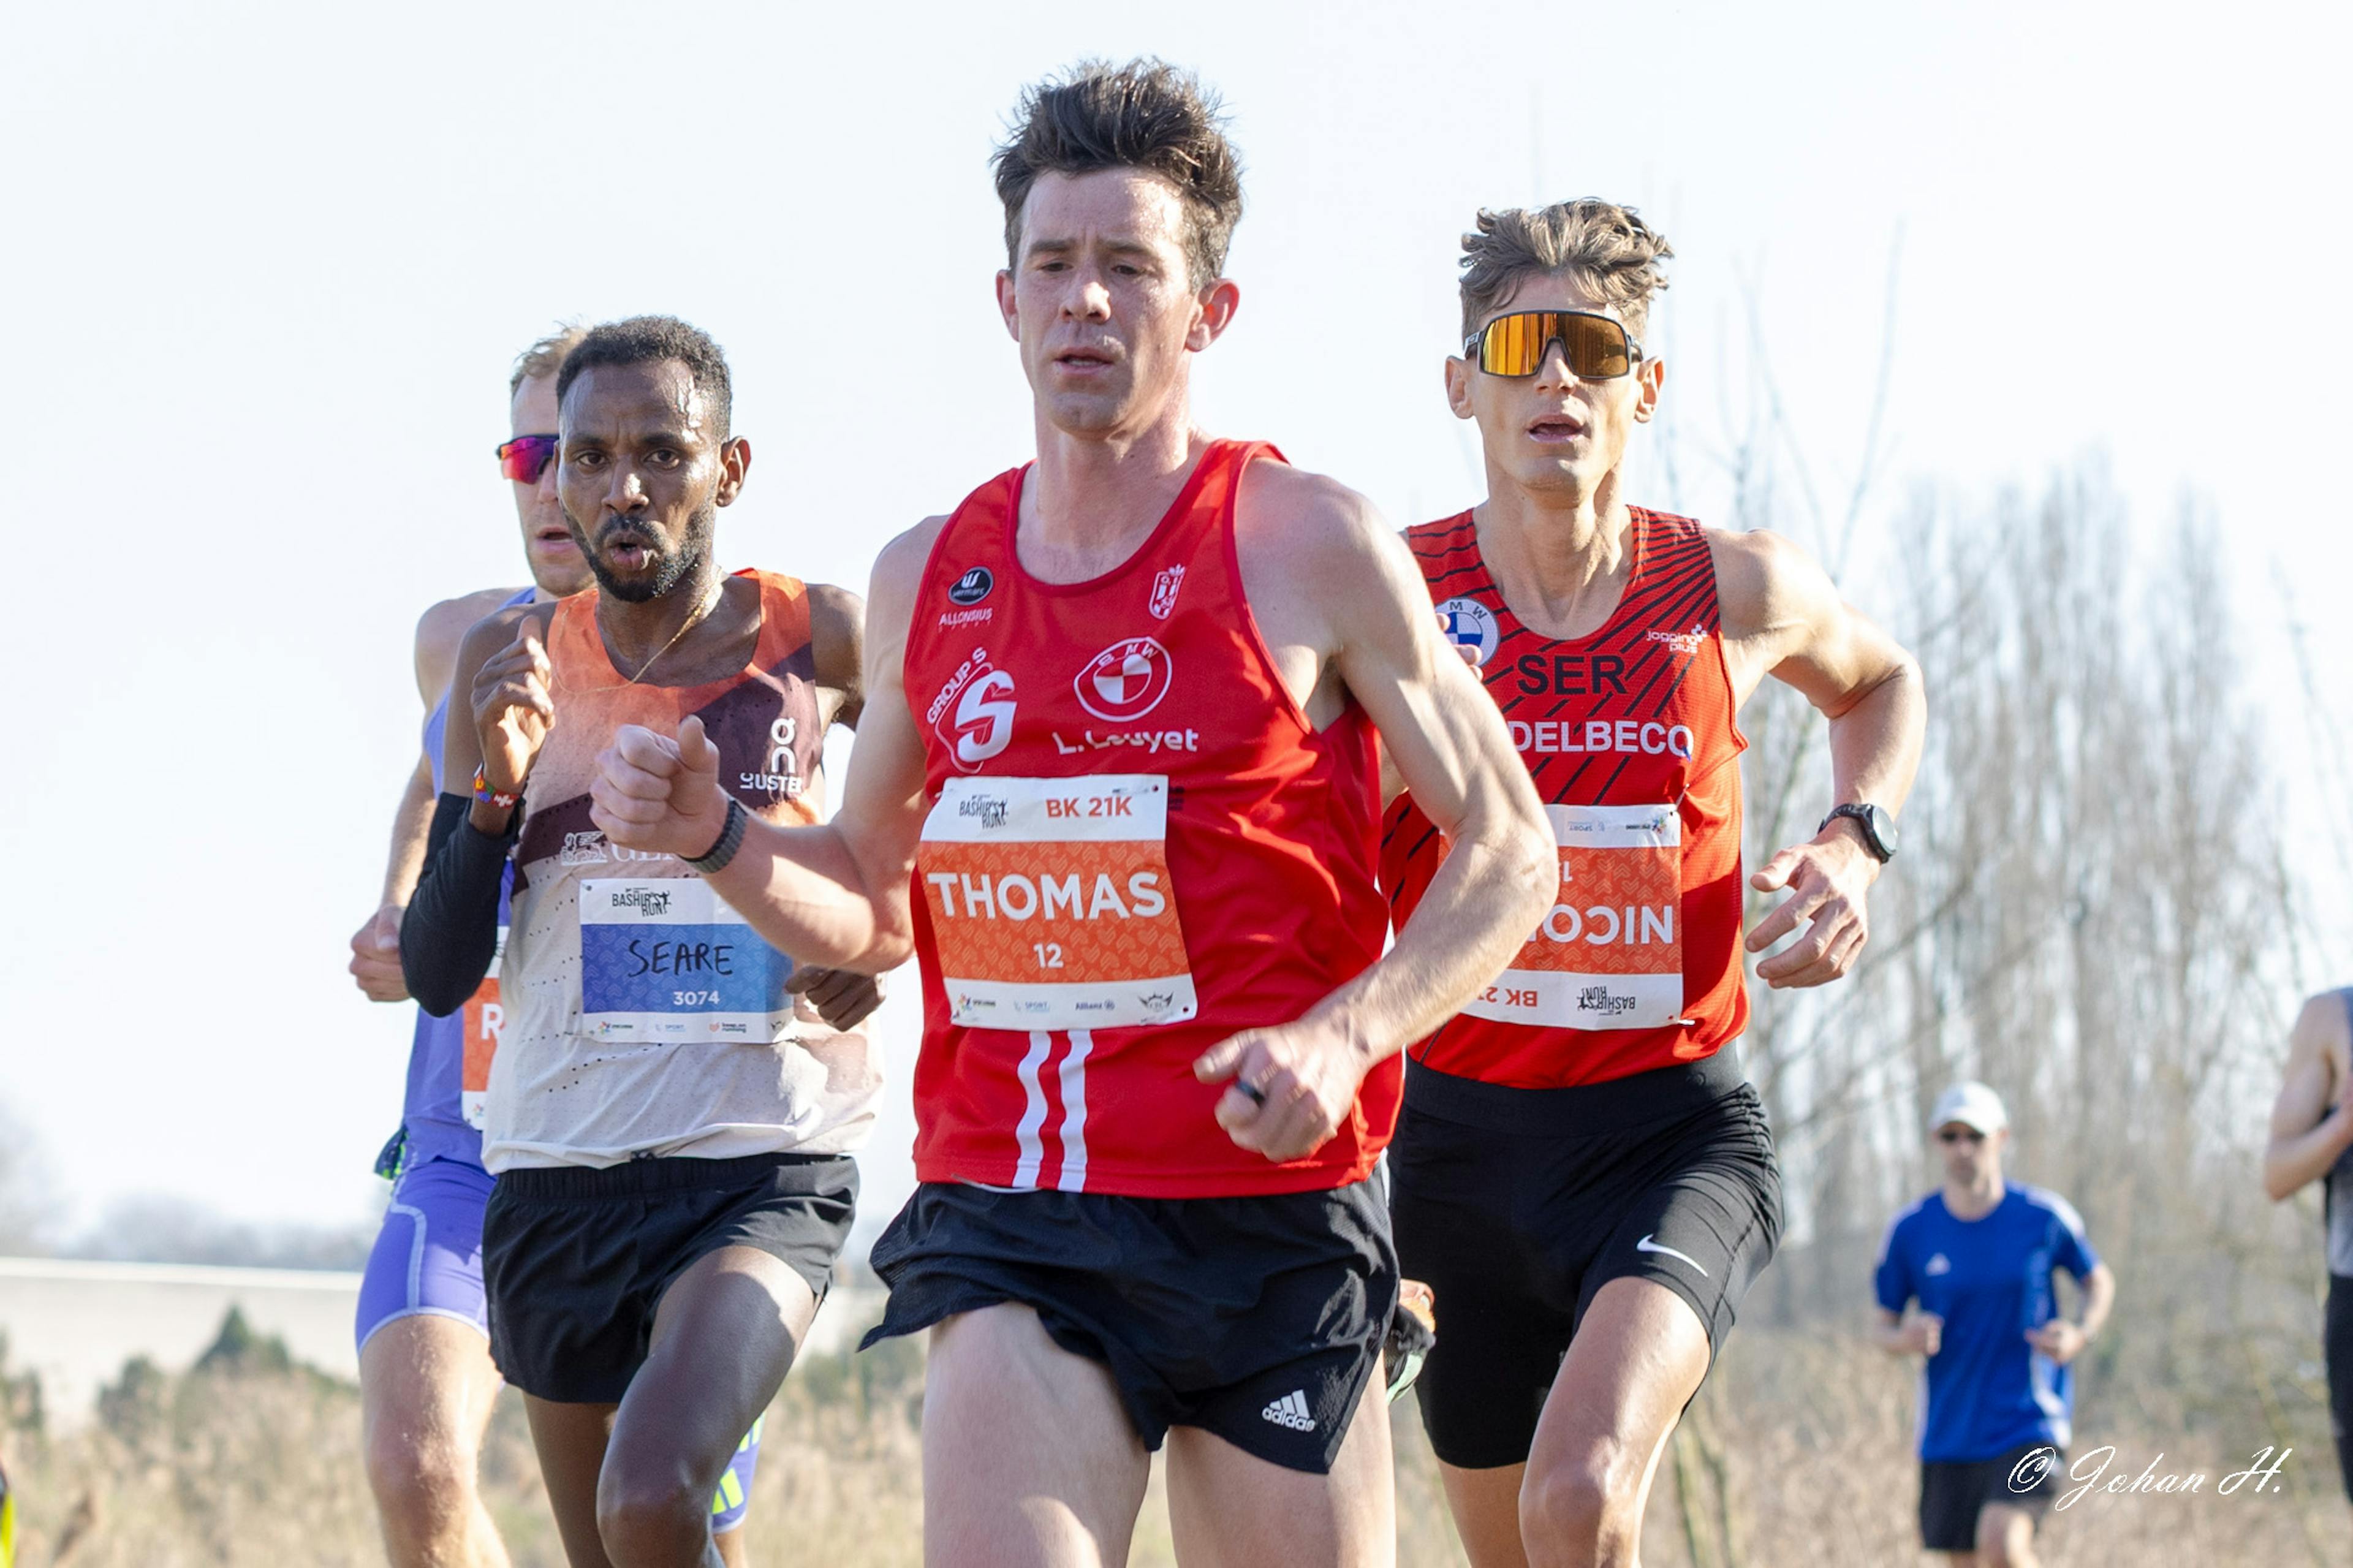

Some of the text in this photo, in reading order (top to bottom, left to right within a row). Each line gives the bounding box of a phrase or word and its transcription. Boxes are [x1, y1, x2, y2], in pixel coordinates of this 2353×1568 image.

[1097, 642, 1160, 668] BMW
[926, 646, 987, 724] GROUP S
[1517, 654, 1628, 695] SER
[1046, 796, 1132, 819] BK 21K
[926, 871, 1165, 920] THOMAS
[1529, 903, 1673, 945] NICO
[628, 939, 735, 978] SEARE
[1033, 943, 1064, 969] 12
[673, 990, 720, 1006] 3074
[1477, 987, 1538, 1007] BK 2
[1262, 1407, 1316, 1432] adidas
